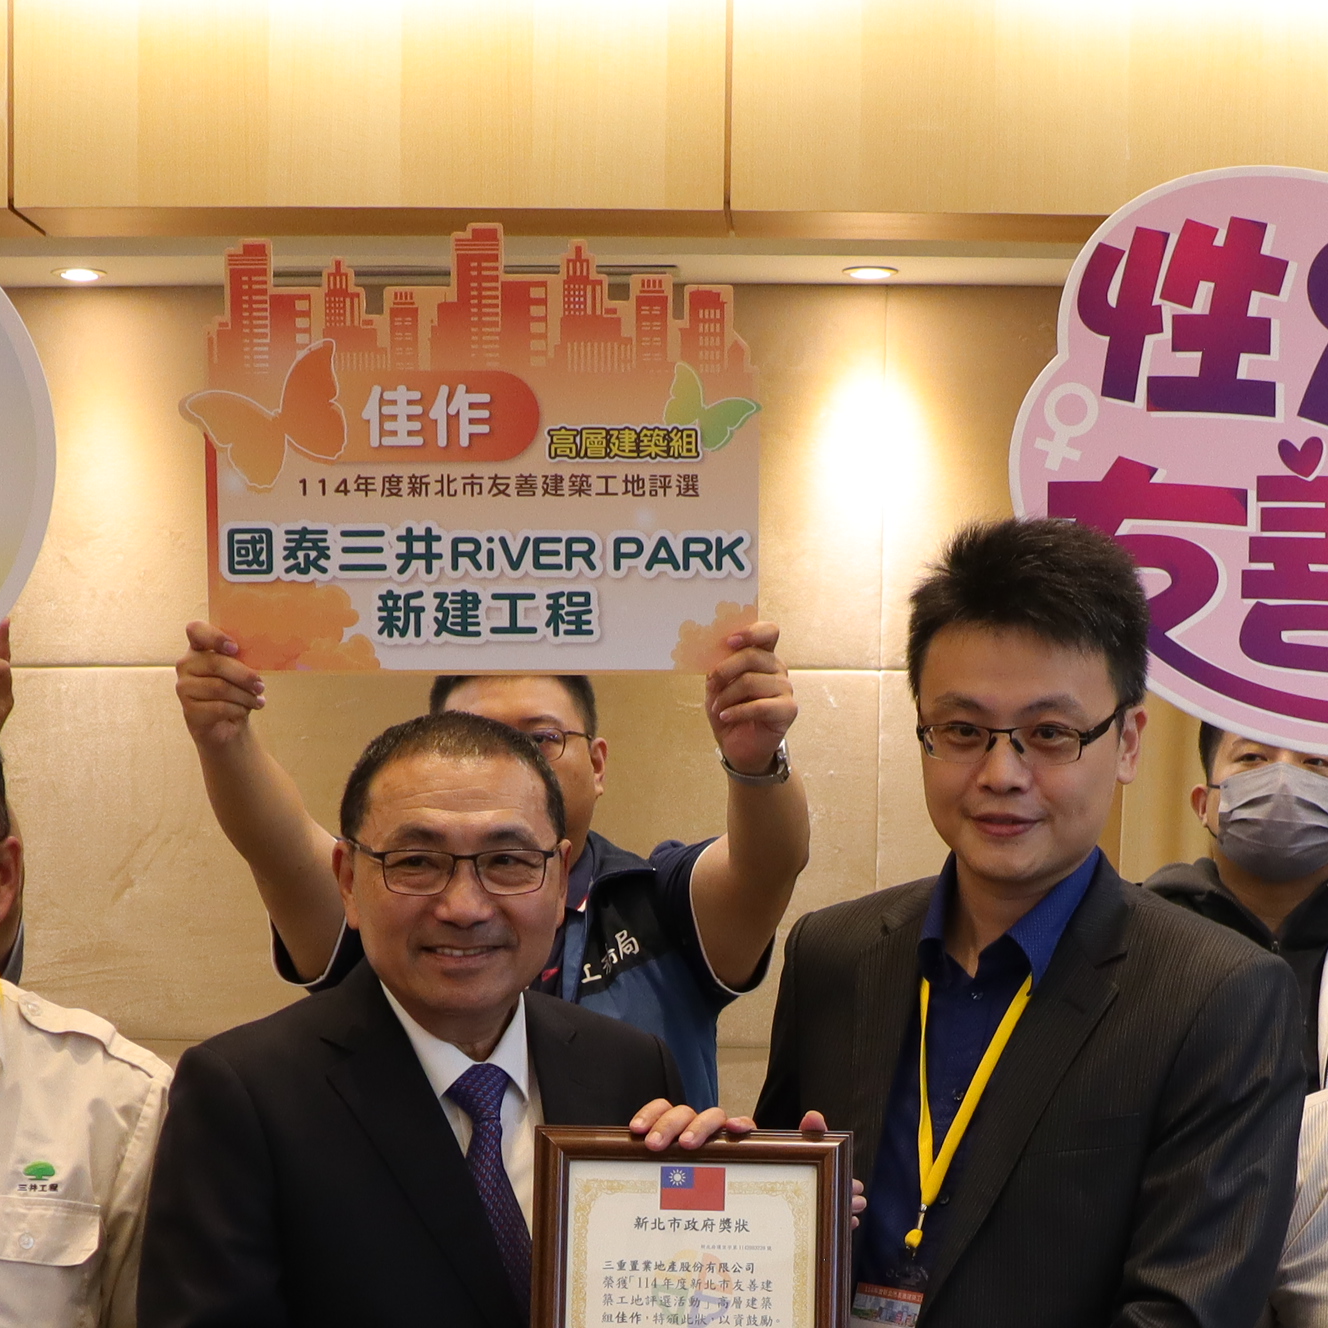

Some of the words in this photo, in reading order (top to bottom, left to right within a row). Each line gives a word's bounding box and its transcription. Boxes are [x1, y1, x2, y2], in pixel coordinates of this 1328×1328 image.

[360, 383, 493, 448] 佳作
[547, 427, 701, 460] 高層建築組
[297, 472, 701, 498] 114年度新北市友善建築工地評選
[613, 536, 745, 572] PARK
[376, 589, 594, 639] 新建工程
[17, 1183, 59, 1193] 三井工程
[633, 1215, 751, 1234] 新北市政府獎狀
[601, 1259, 755, 1274] 三重置業地產股份有限公司
